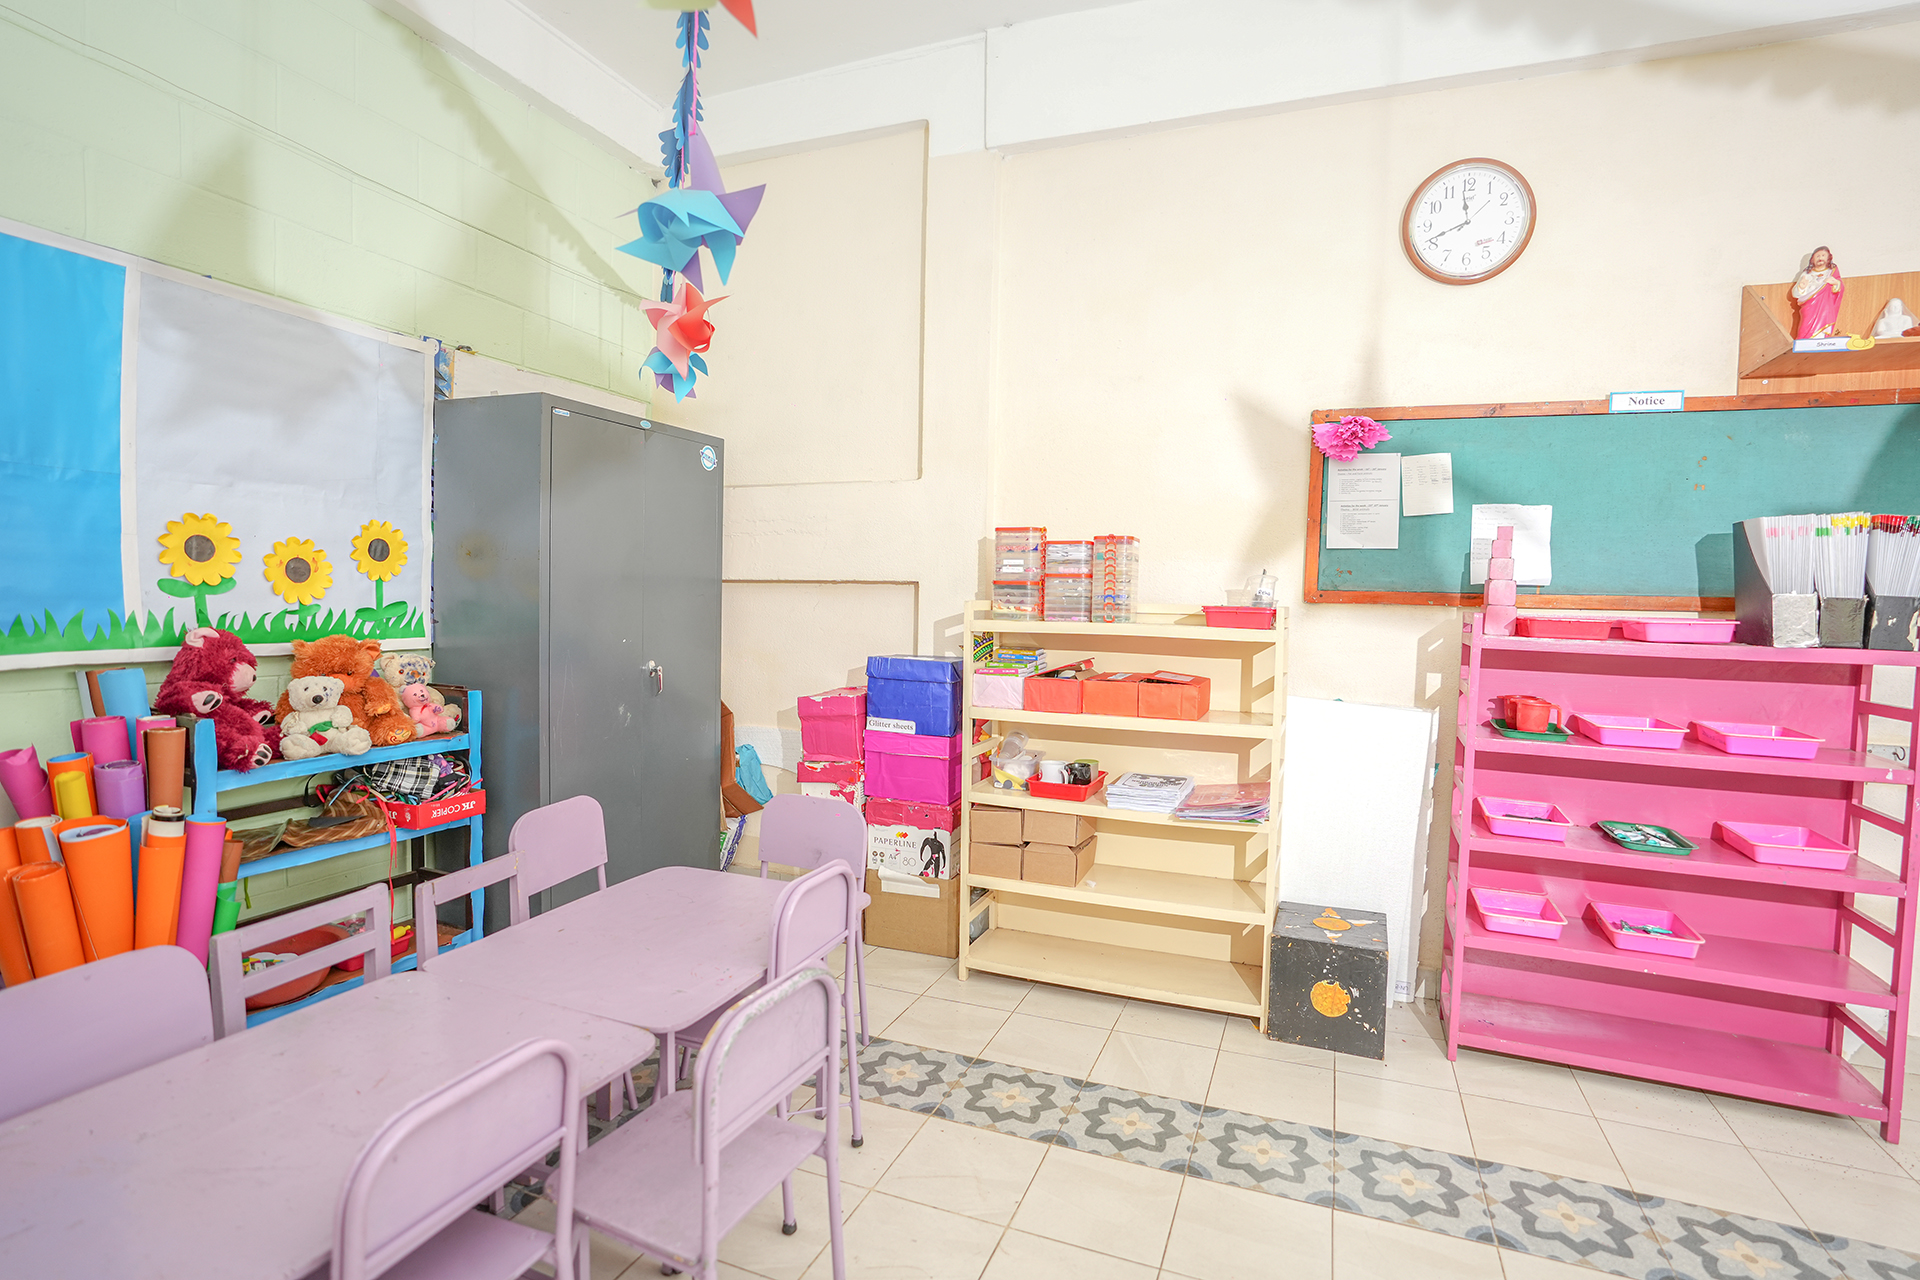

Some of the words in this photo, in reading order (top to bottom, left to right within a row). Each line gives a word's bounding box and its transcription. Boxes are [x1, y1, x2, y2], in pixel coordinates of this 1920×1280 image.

[1462, 177, 1477, 192] 12
[1487, 180, 1493, 195] 1
[1444, 185, 1455, 199] 11
[1499, 192, 1509, 206] 2
[1430, 200, 1442, 214] 10
[1504, 211, 1514, 225] 3
[1423, 219, 1433, 233] 9
[1428, 237, 1439, 251] 8
[1496, 231, 1506, 244] 4
[1442, 249, 1452, 262] 7
[1461, 252, 1471, 266] 6
[1481, 245, 1491, 260] 5
[1628, 396, 1665, 406] Notice
[868, 719, 891, 728] Glitter
[892, 722, 914, 730] sheets
[432, 804, 460, 818] COPIER
[461, 800, 476, 811] JK
[873, 836, 917, 849] PAPERLINE
[902, 856, 917, 867] 80
